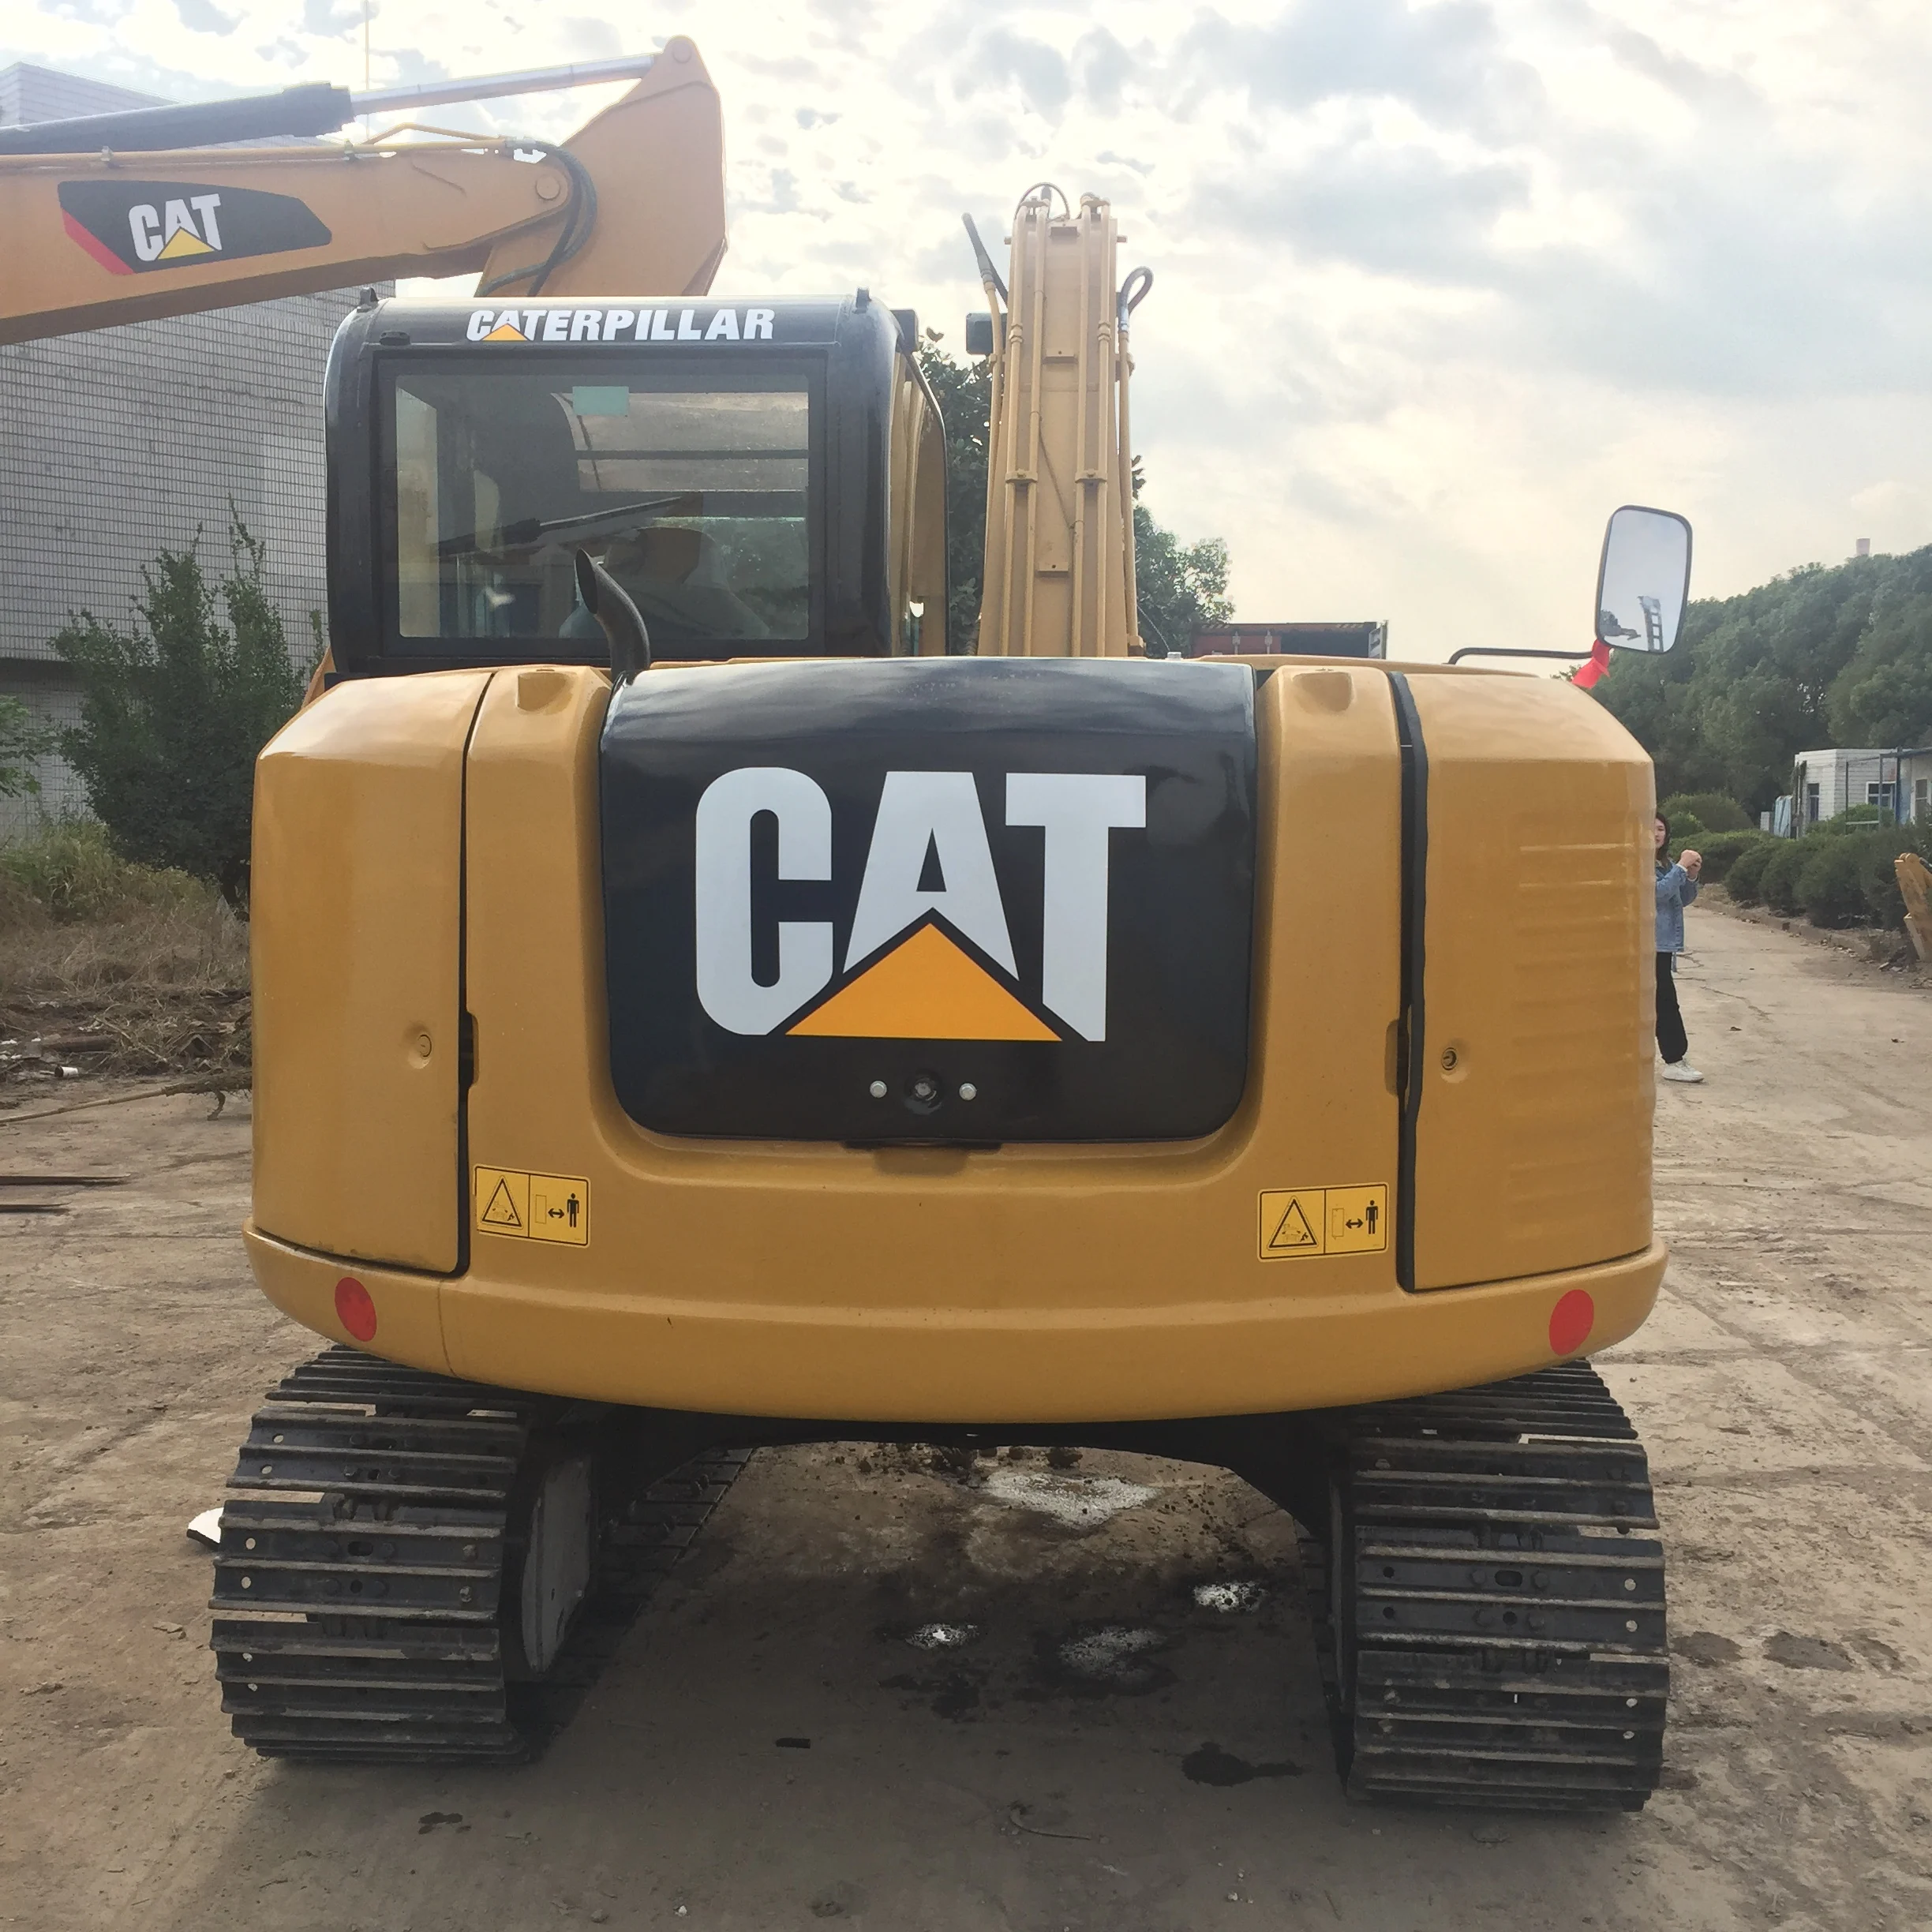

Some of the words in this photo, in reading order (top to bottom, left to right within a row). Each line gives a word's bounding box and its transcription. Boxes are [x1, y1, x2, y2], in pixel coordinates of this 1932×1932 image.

[128, 193, 223, 261] CAT
[466, 309, 775, 342] CATERPILLAR
[696, 767, 1147, 1043] CAT
